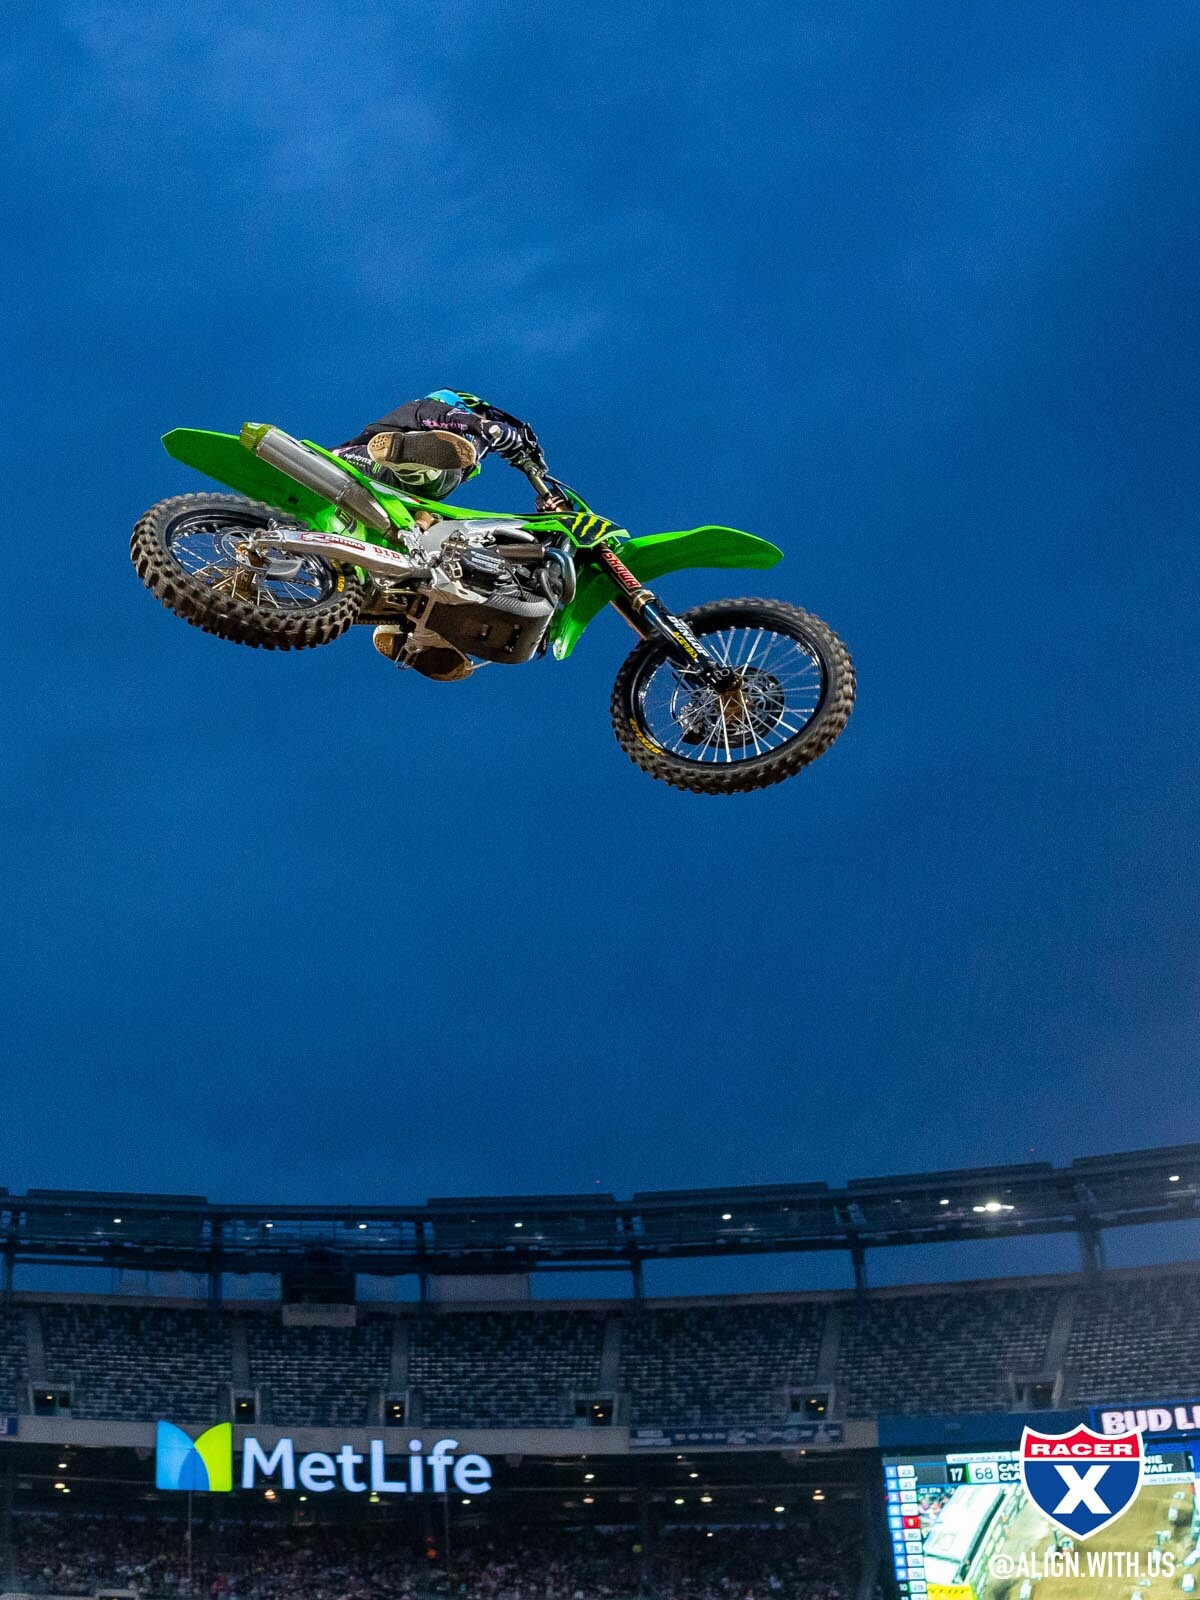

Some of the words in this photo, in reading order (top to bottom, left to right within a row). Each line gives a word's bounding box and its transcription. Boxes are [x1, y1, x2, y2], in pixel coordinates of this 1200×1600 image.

[602, 551, 642, 589] SHOWA
[666, 614, 710, 657] DUNLOP
[1101, 1408, 1173, 1434] BUD
[241, 1437, 493, 1494] MetLife
[950, 1468, 963, 1481] 17
[975, 1467, 993, 1480] 68
[999, 1463, 1021, 1473] CAD
